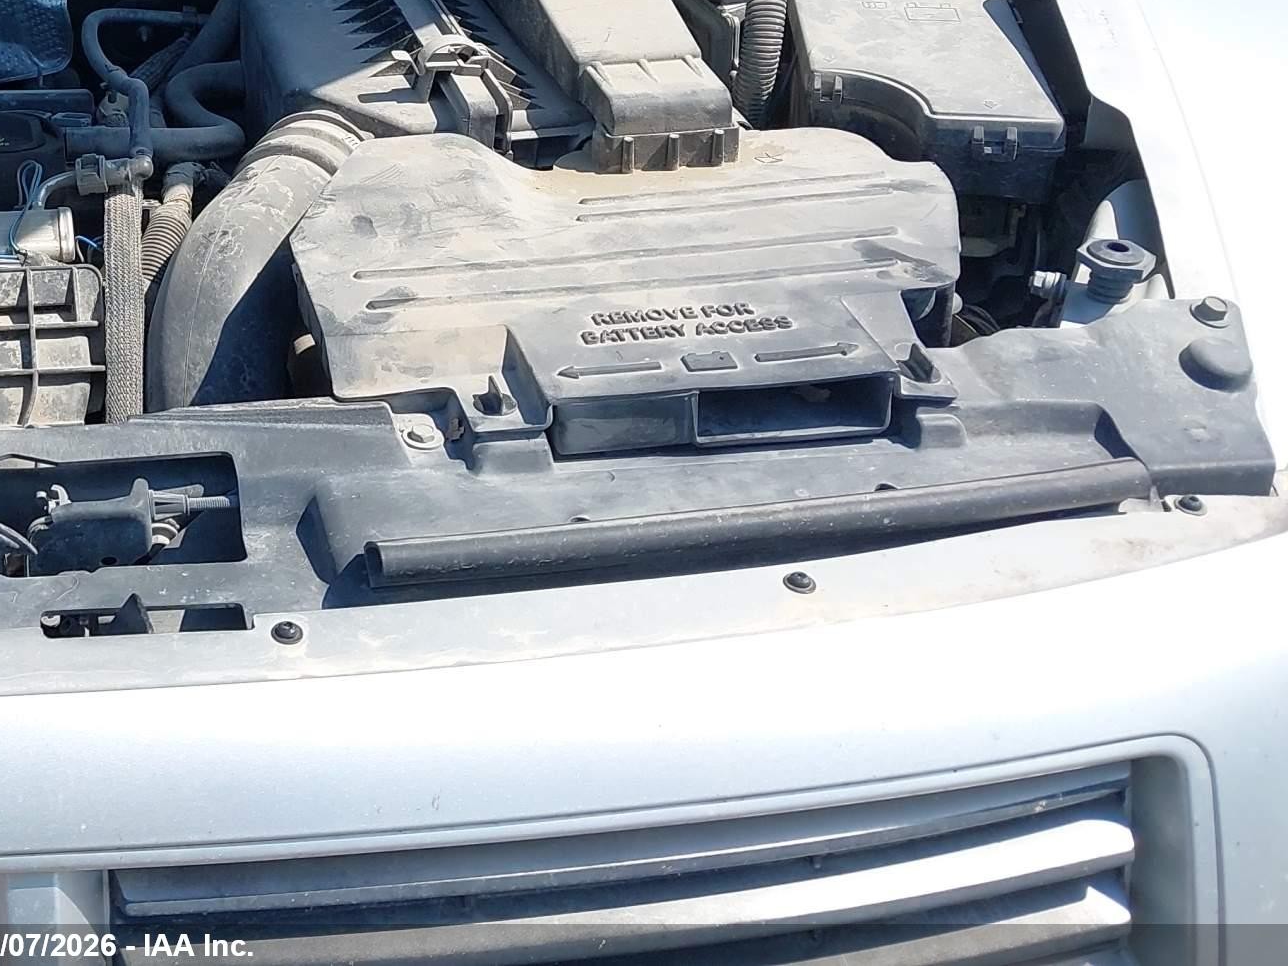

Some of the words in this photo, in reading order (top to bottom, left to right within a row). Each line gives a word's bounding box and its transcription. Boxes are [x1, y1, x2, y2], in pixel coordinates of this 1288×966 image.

[591, 306, 698, 326] REMOVE
[700, 302, 755, 318] FOR
[580, 323, 687, 345] BATTERY
[695, 315, 793, 336] ACCESS
